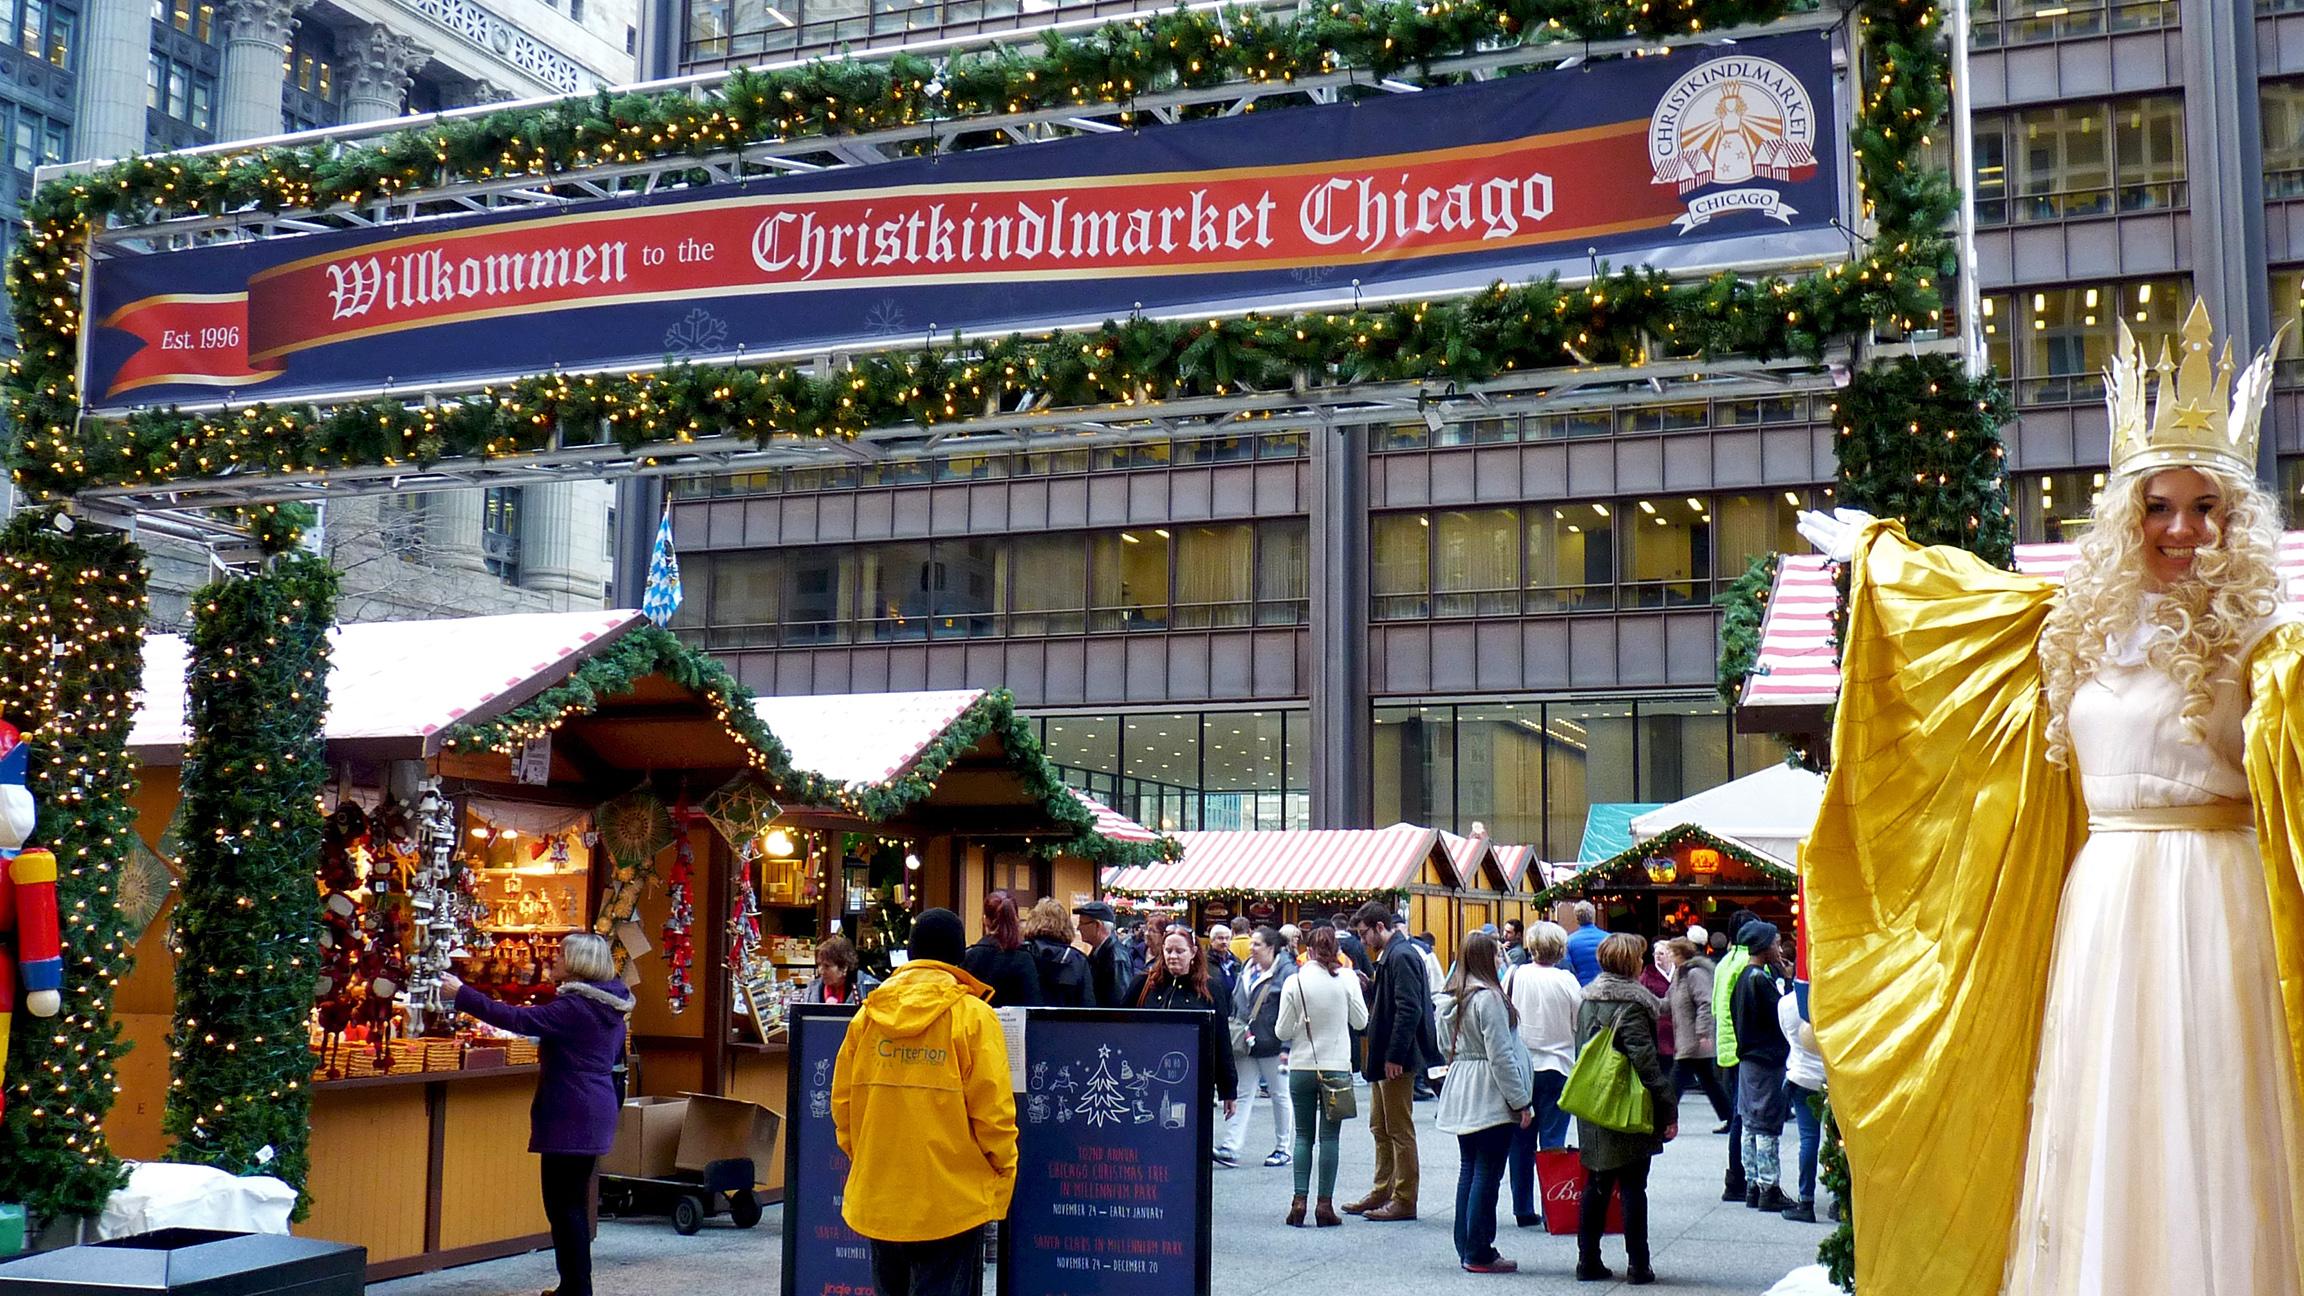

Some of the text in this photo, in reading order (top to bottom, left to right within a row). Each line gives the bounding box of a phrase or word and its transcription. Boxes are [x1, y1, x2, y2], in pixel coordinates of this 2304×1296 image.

[1657, 62, 1807, 156] CHRISTKINDLMARKET
[1694, 193, 1774, 214] CHICAGO
[326, 171, 1556, 321] Willkommen to the Christkindlmarket Chicago
[161, 326, 239, 350] Est. 1996
[878, 1039, 947, 1062] Criterion
[1049, 1163, 1169, 1182] CHICAGO CHRISTMAS TREE
[1061, 1182, 1158, 1200] IN MILLENNIUM PARK
[1053, 1203, 1085, 1217] NOVEMBER
[1088, 1204, 1097, 1217] 24
[1109, 1205, 1130, 1219] EARLY
[1133, 1207, 1164, 1220] JANUARY
[835, 1247, 866, 1259] NOVEMBER
[1033, 1234, 1184, 1256] SANTA CLAUS IN MILLENNIUM PARK
[1056, 1256, 1089, 1270] NOVEMBER
[1092, 1257, 1100, 1270] 24
[1113, 1259, 1146, 1273] DECEMBER
[1149, 1260, 1158, 1273] 20
